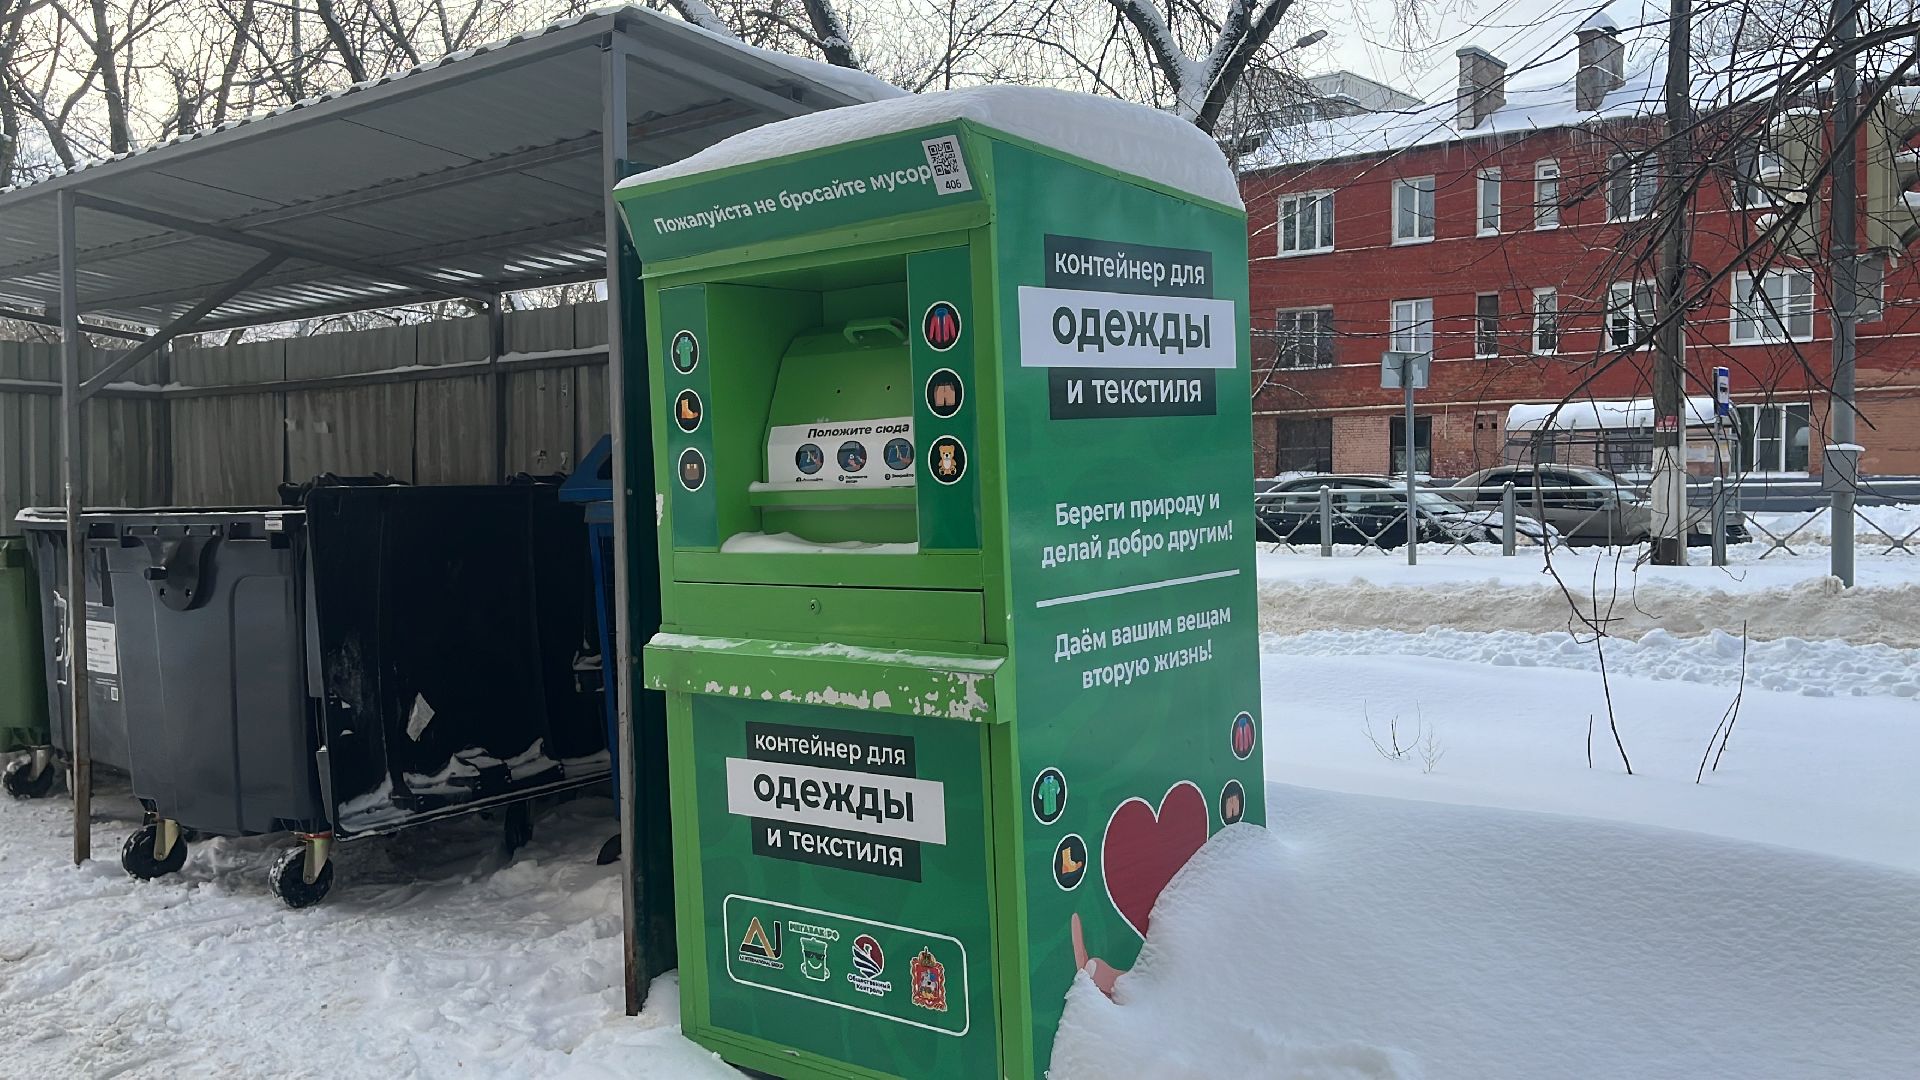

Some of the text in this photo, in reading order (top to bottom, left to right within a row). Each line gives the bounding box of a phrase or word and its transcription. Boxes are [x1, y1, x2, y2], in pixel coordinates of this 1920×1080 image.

[653, 164, 932, 235] Пожалуйста не бросайте мусор
[945, 178, 962, 190] 406
[1055, 251, 1205, 287] контейнер для
[1052, 306, 1211, 355] одежды
[1067, 379, 1202, 404] и текстиля
[807, 423, 910, 439] Положите сюда
[1055, 492, 1220, 529] Береги природу и
[1041, 519, 1233, 569] делай добро другим!
[1054, 606, 1231, 663] Даём вашим вещам
[1082, 638, 1213, 689] вторую жизнь!
[755, 734, 906, 766] контейнер для
[753, 773, 914, 824] одежды
[766, 827, 903, 868] и текстиля
